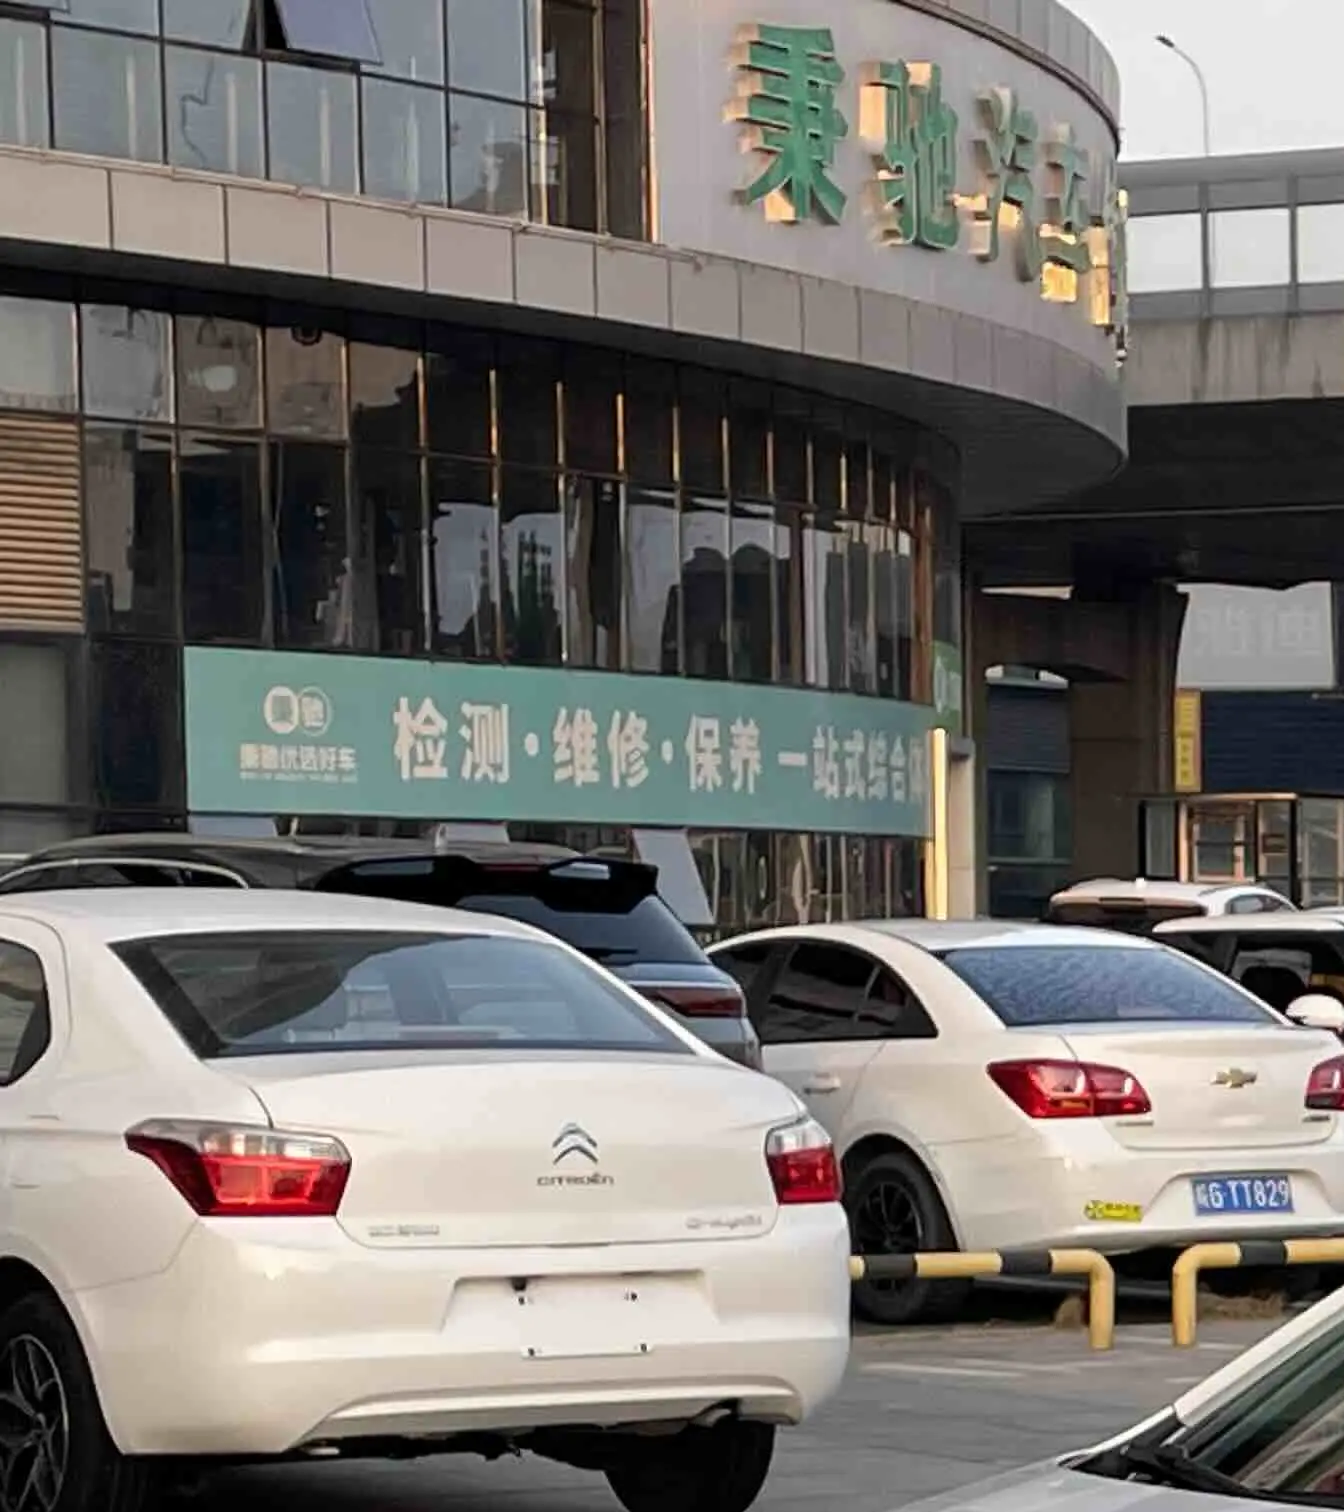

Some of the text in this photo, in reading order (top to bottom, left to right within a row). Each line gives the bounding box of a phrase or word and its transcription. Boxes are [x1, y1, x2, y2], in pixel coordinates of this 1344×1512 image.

[722, 22, 1129, 366] 秉驰汽车
[393, 697, 762, 795] 检测·维修·保养
